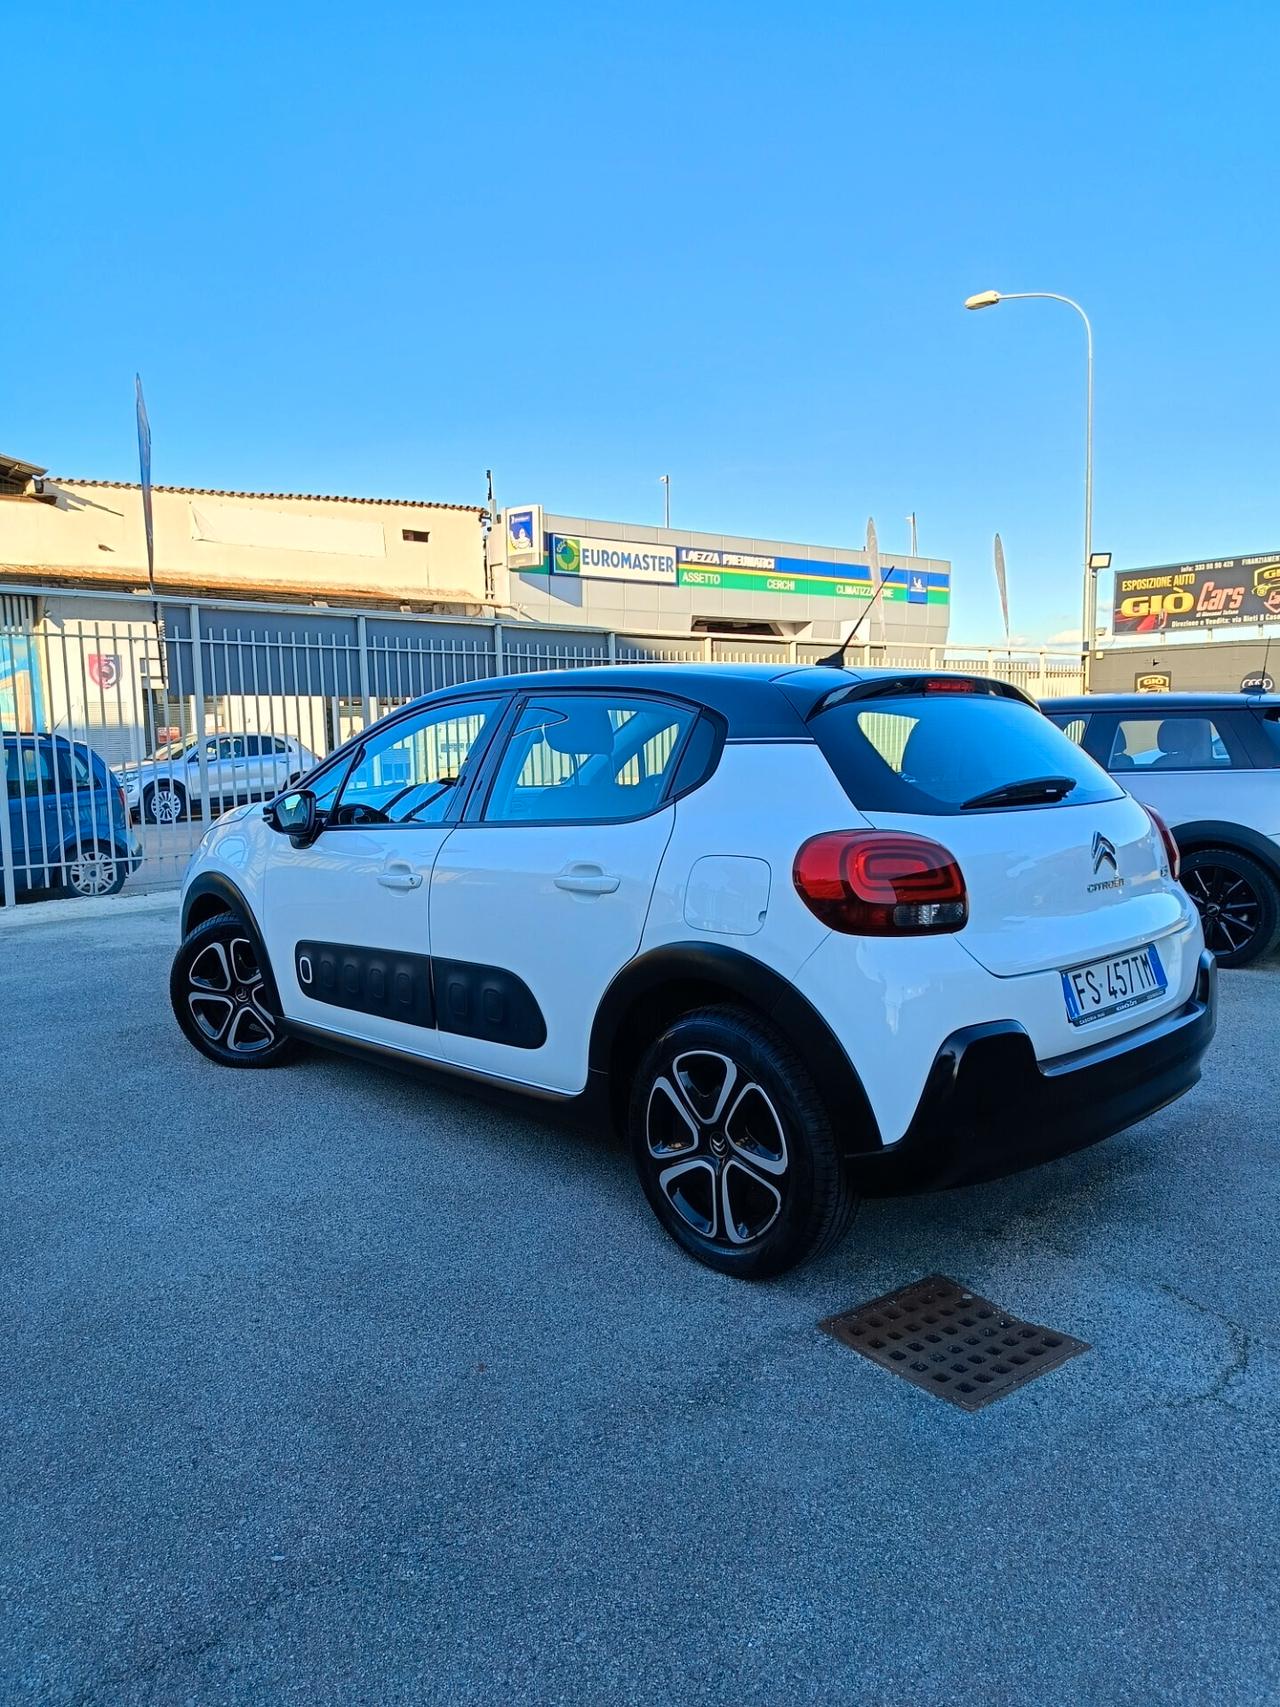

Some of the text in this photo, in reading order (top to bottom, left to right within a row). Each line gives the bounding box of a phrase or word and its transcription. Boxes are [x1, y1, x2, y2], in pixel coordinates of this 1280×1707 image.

[582, 548, 674, 573] EUROMASTER
[682, 550, 720, 564] LAEZZA
[682, 571, 720, 584] ASSETTO
[767, 578, 795, 591] CERCHI
[1122, 573, 1196, 592] ESPOSIZIONE AUTO
[1120, 581, 1245, 618] GIÒ Cars
[1071, 951, 1157, 1010] FS 457TM
